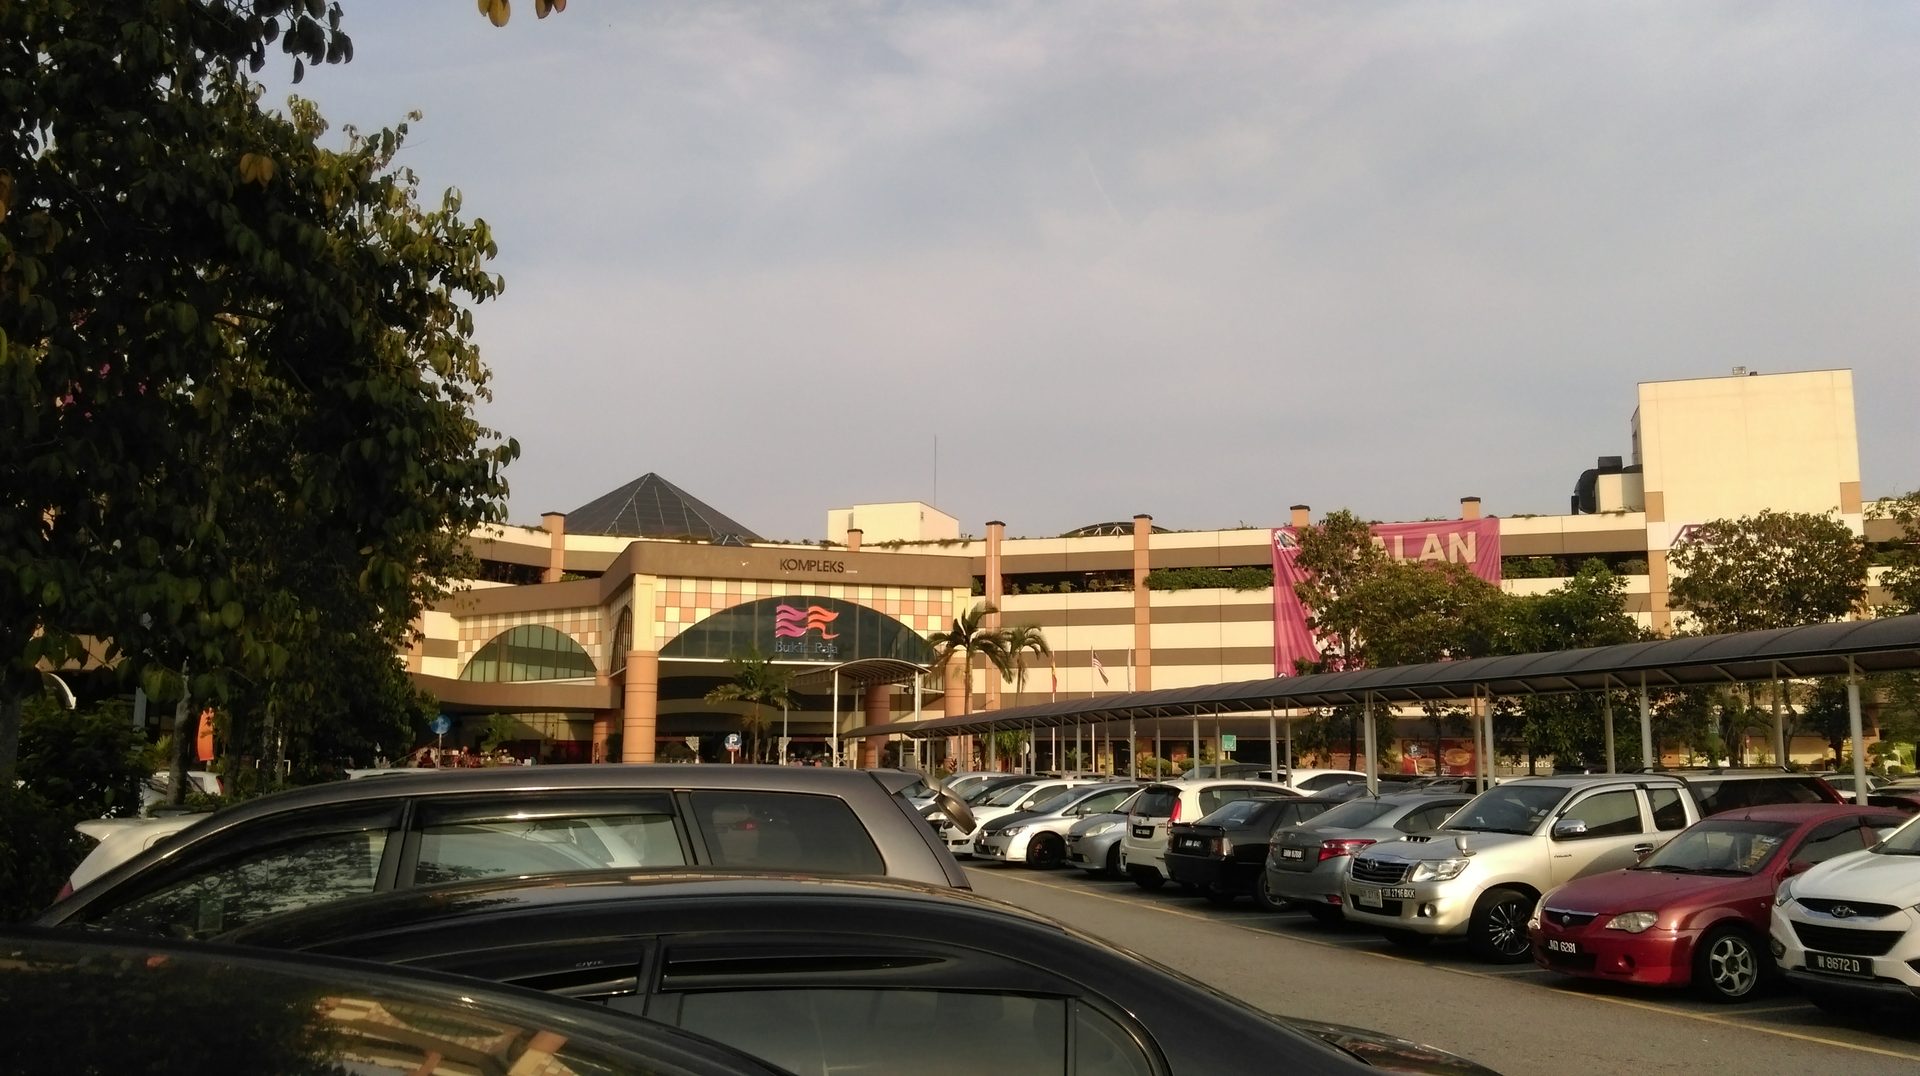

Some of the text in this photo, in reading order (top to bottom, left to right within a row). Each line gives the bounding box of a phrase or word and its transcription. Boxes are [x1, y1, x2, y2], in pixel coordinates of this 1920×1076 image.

[1371, 531, 1477, 566] ALAN
[780, 559, 844, 573] KOMPLEKS
[1560, 941, 1576, 954] 6281
[1826, 956, 1851, 971] 8672
[1852, 959, 1860, 972] D
